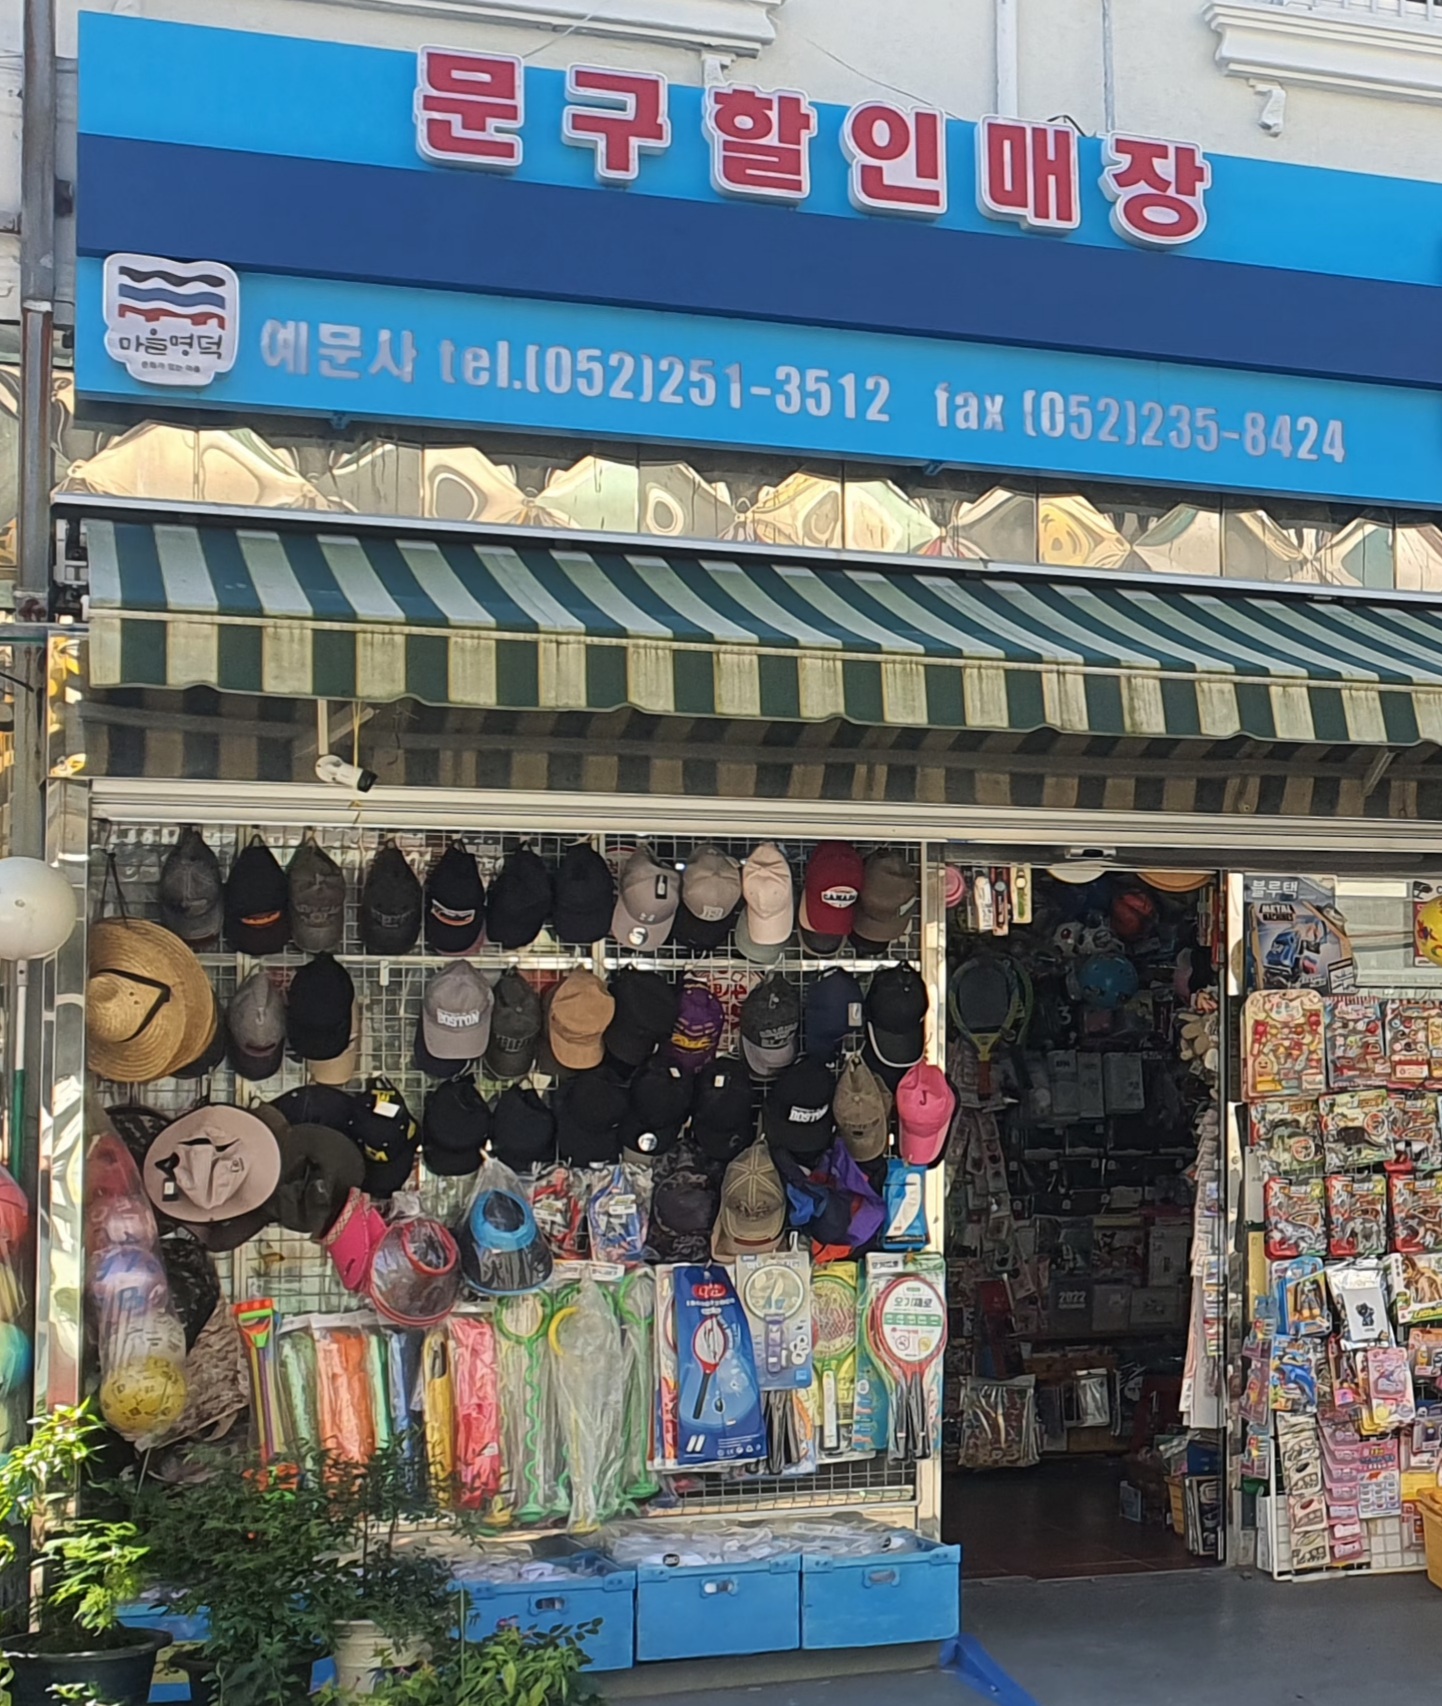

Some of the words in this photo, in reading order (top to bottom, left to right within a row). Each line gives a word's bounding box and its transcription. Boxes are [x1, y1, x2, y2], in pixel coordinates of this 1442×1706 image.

[118, 327, 223, 360] 마을명덕
[260, 318, 418, 383] 예문사
[934, 382, 1005, 432] fax
[1023, 388, 1347, 463] (052)235-8424
